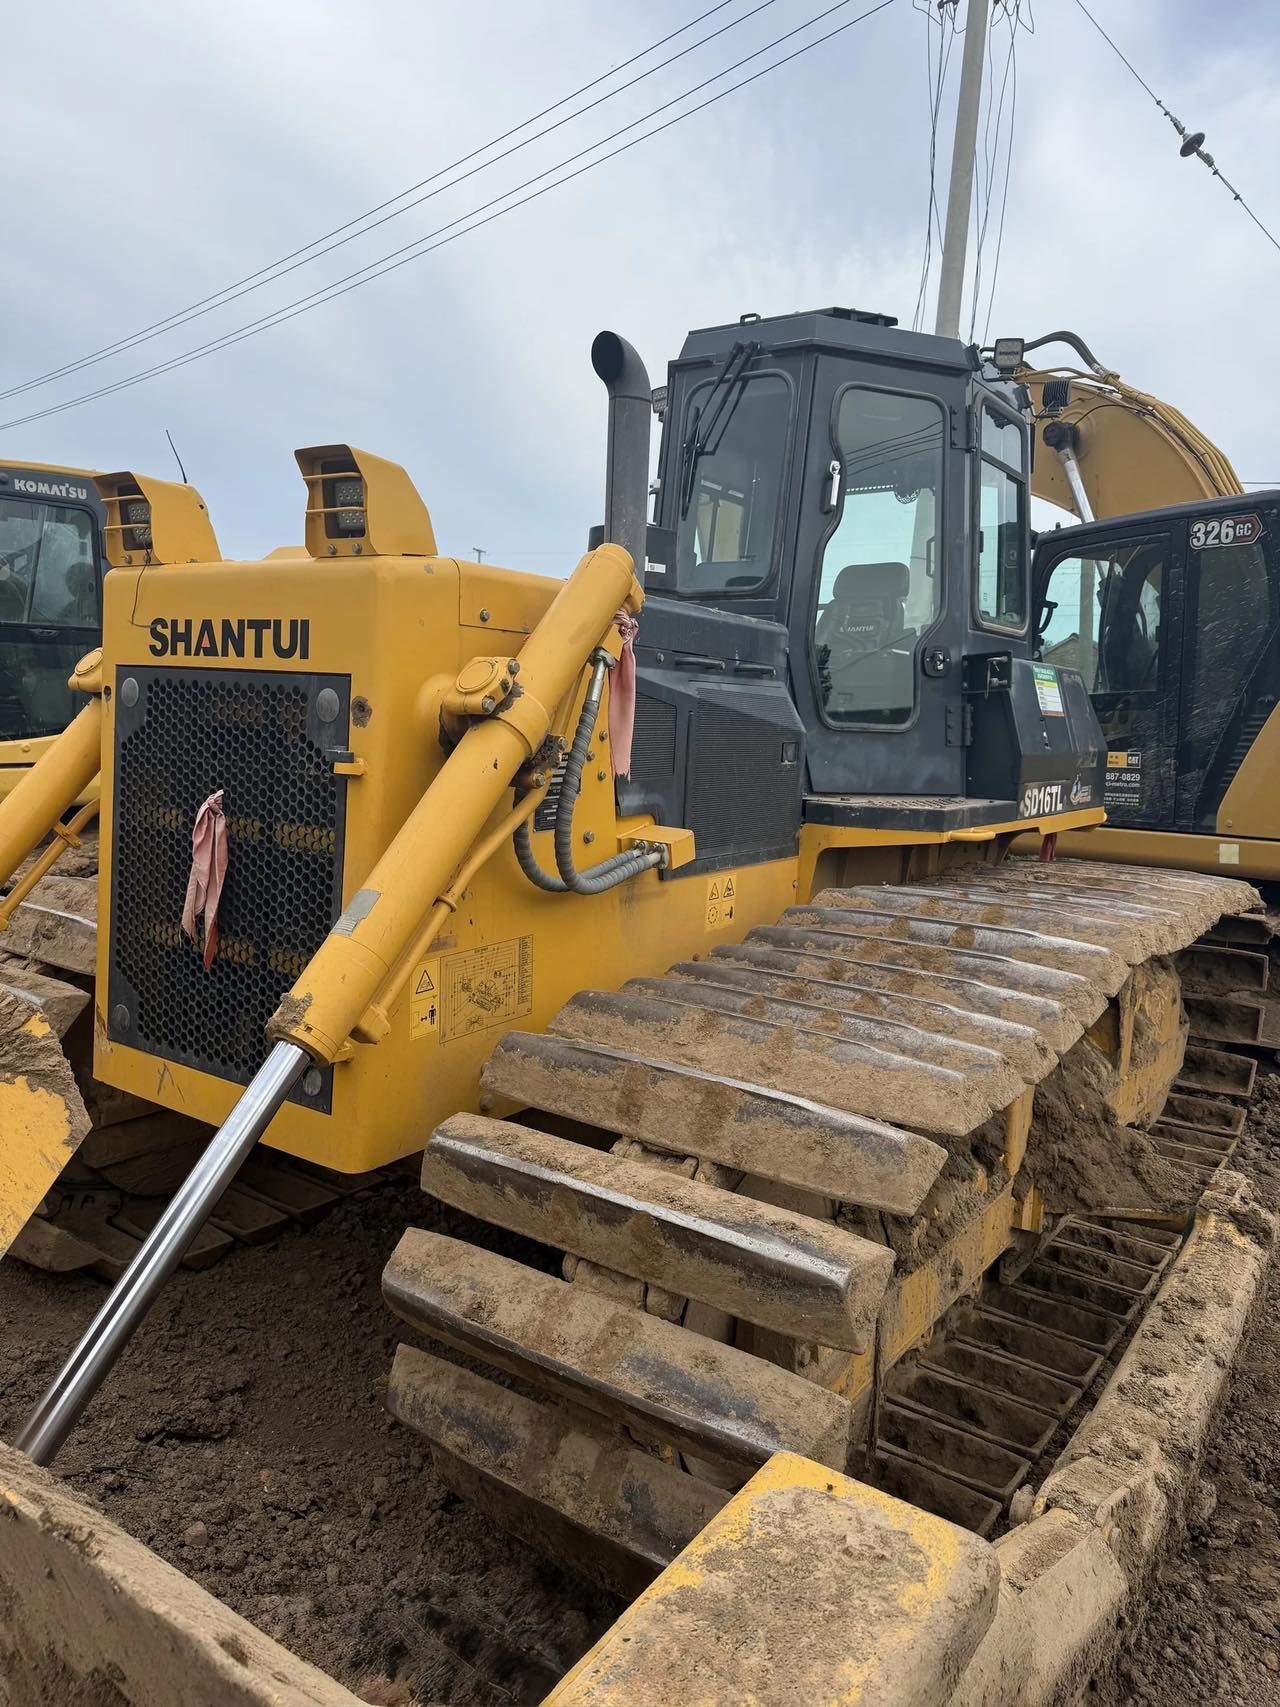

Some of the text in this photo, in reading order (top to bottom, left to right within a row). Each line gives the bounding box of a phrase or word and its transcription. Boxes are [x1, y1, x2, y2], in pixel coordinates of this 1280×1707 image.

[14, 479, 87, 499] KOMATSU
[1192, 519, 1252, 547] 326 GC
[149, 618, 310, 660] SHANTUI
[1023, 784, 1063, 817] SD16TL
